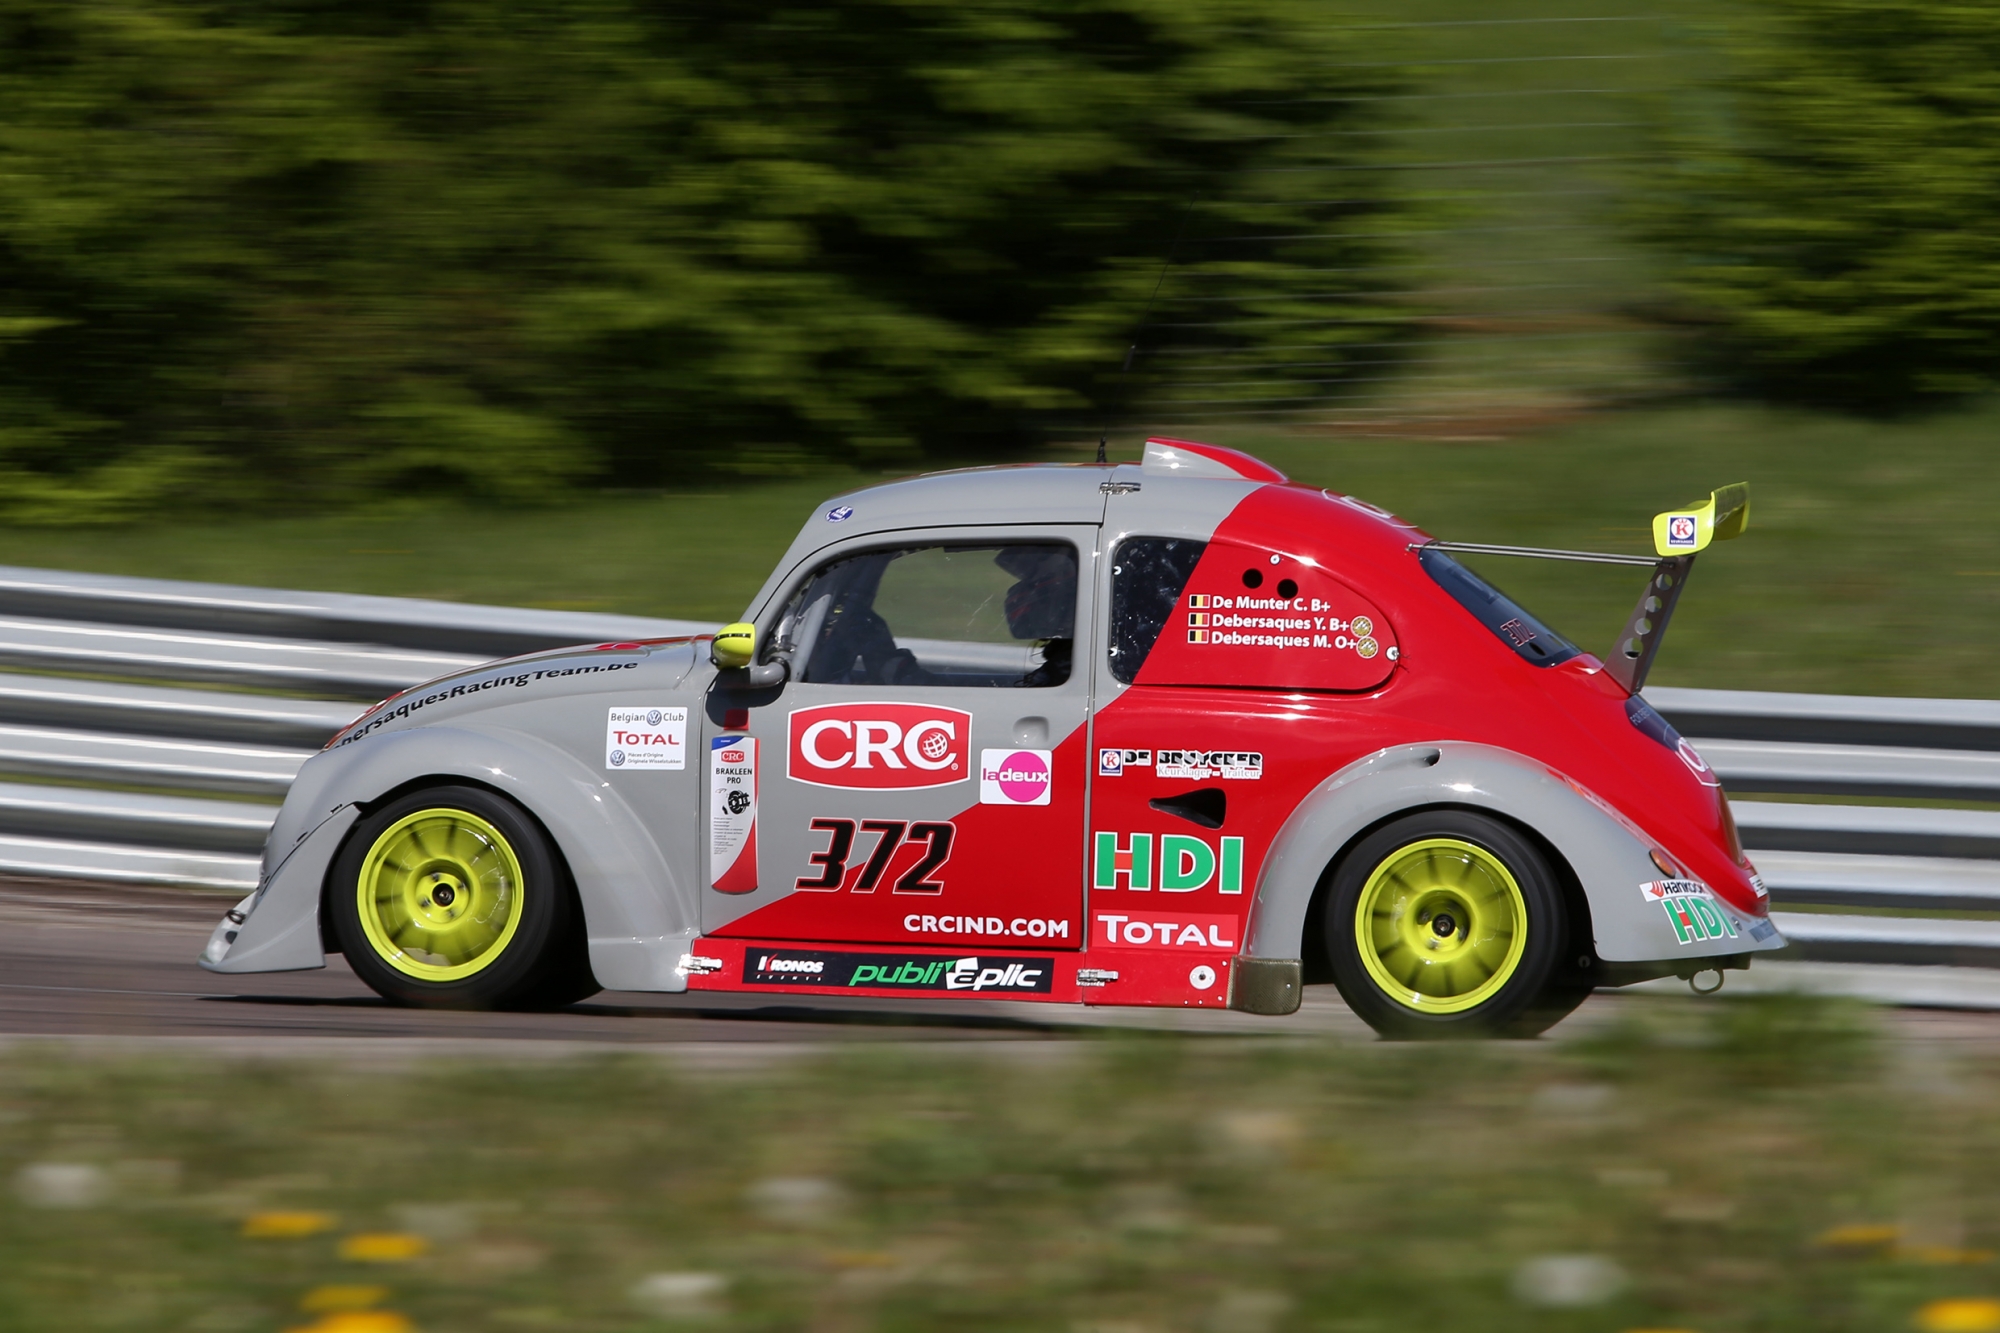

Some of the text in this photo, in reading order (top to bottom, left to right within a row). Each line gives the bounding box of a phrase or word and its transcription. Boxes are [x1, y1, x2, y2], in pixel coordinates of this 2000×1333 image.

[1212, 595, 1331, 612] De Munter C. B+
[1212, 614, 1350, 632] Debersaques Y. B+
[1211, 631, 1357, 649] Debersaques M. O+
[611, 712, 646, 724] Belgian
[663, 712, 685, 722] Club
[613, 731, 680, 745] TOTAL
[801, 719, 957, 771] CRC
[722, 751, 744, 762] CRC
[1124, 750, 1150, 764] DE
[715, 767, 753, 775] BRAKLEEN
[983, 767, 1049, 783] ladeux
[1158, 766, 1211, 778] Keurslager
[1223, 767, 1260, 777] Traiteur
[726, 776, 742, 784] PRO
[793, 817, 957, 895] 372
[1094, 831, 1244, 894] HDI
[903, 914, 1069, 938] CRCIND.COM
[1661, 896, 1738, 945] HDI
[1097, 914, 1234, 947] TOTAL
[757, 953, 824, 973] KRONOS
